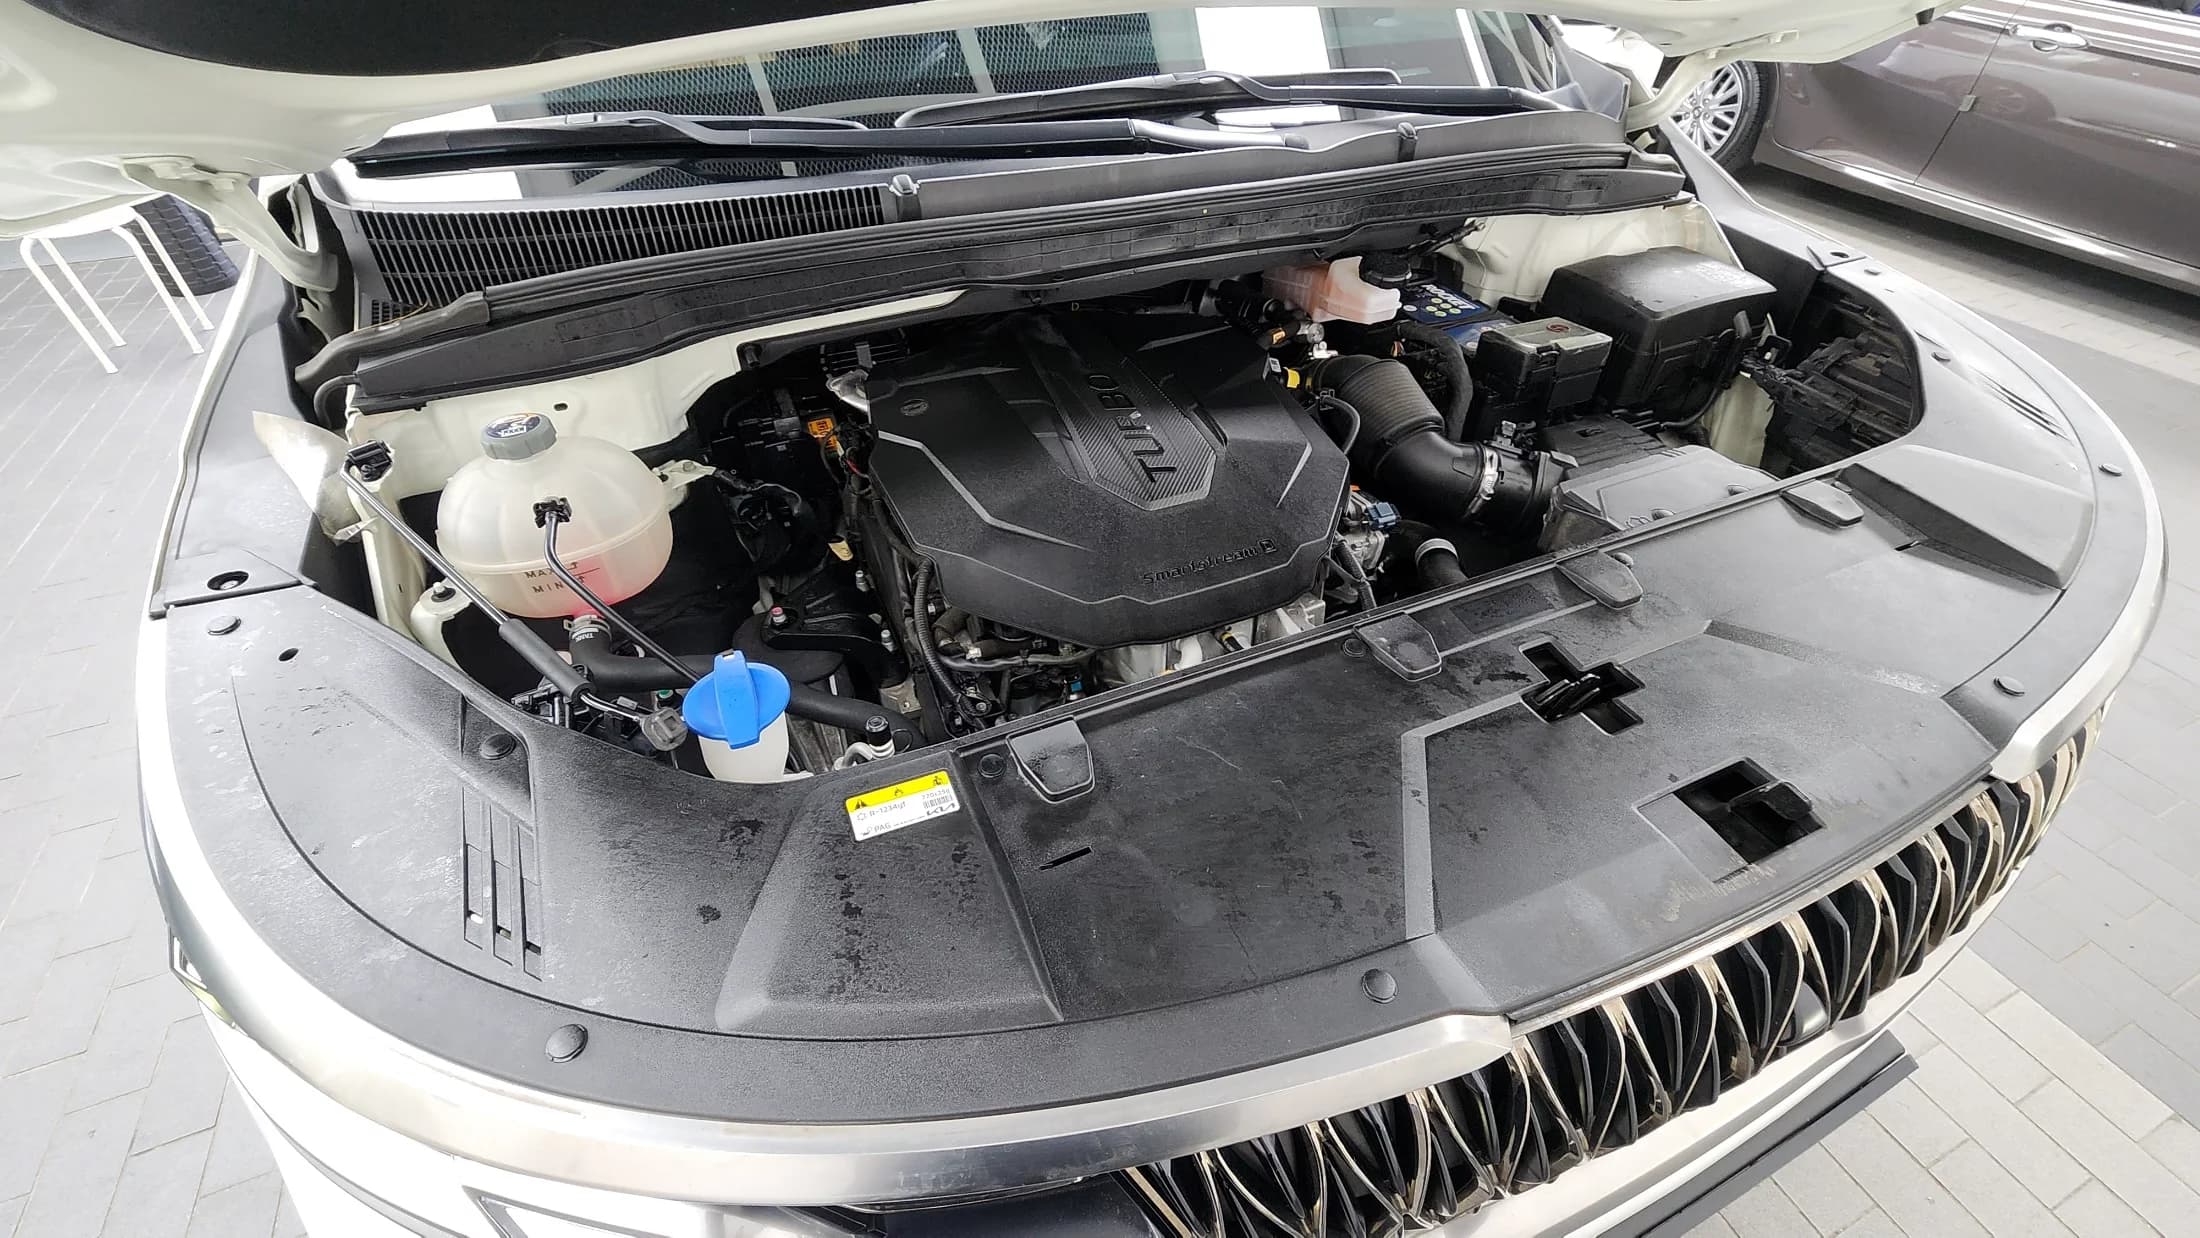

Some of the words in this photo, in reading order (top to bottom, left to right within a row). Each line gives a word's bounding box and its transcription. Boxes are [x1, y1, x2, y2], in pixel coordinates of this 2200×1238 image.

[1087, 375, 1178, 482] TURBO
[1143, 546, 1258, 584] Smartstream
[532, 581, 564, 593] MIN
[873, 822, 892, 833] PAG
